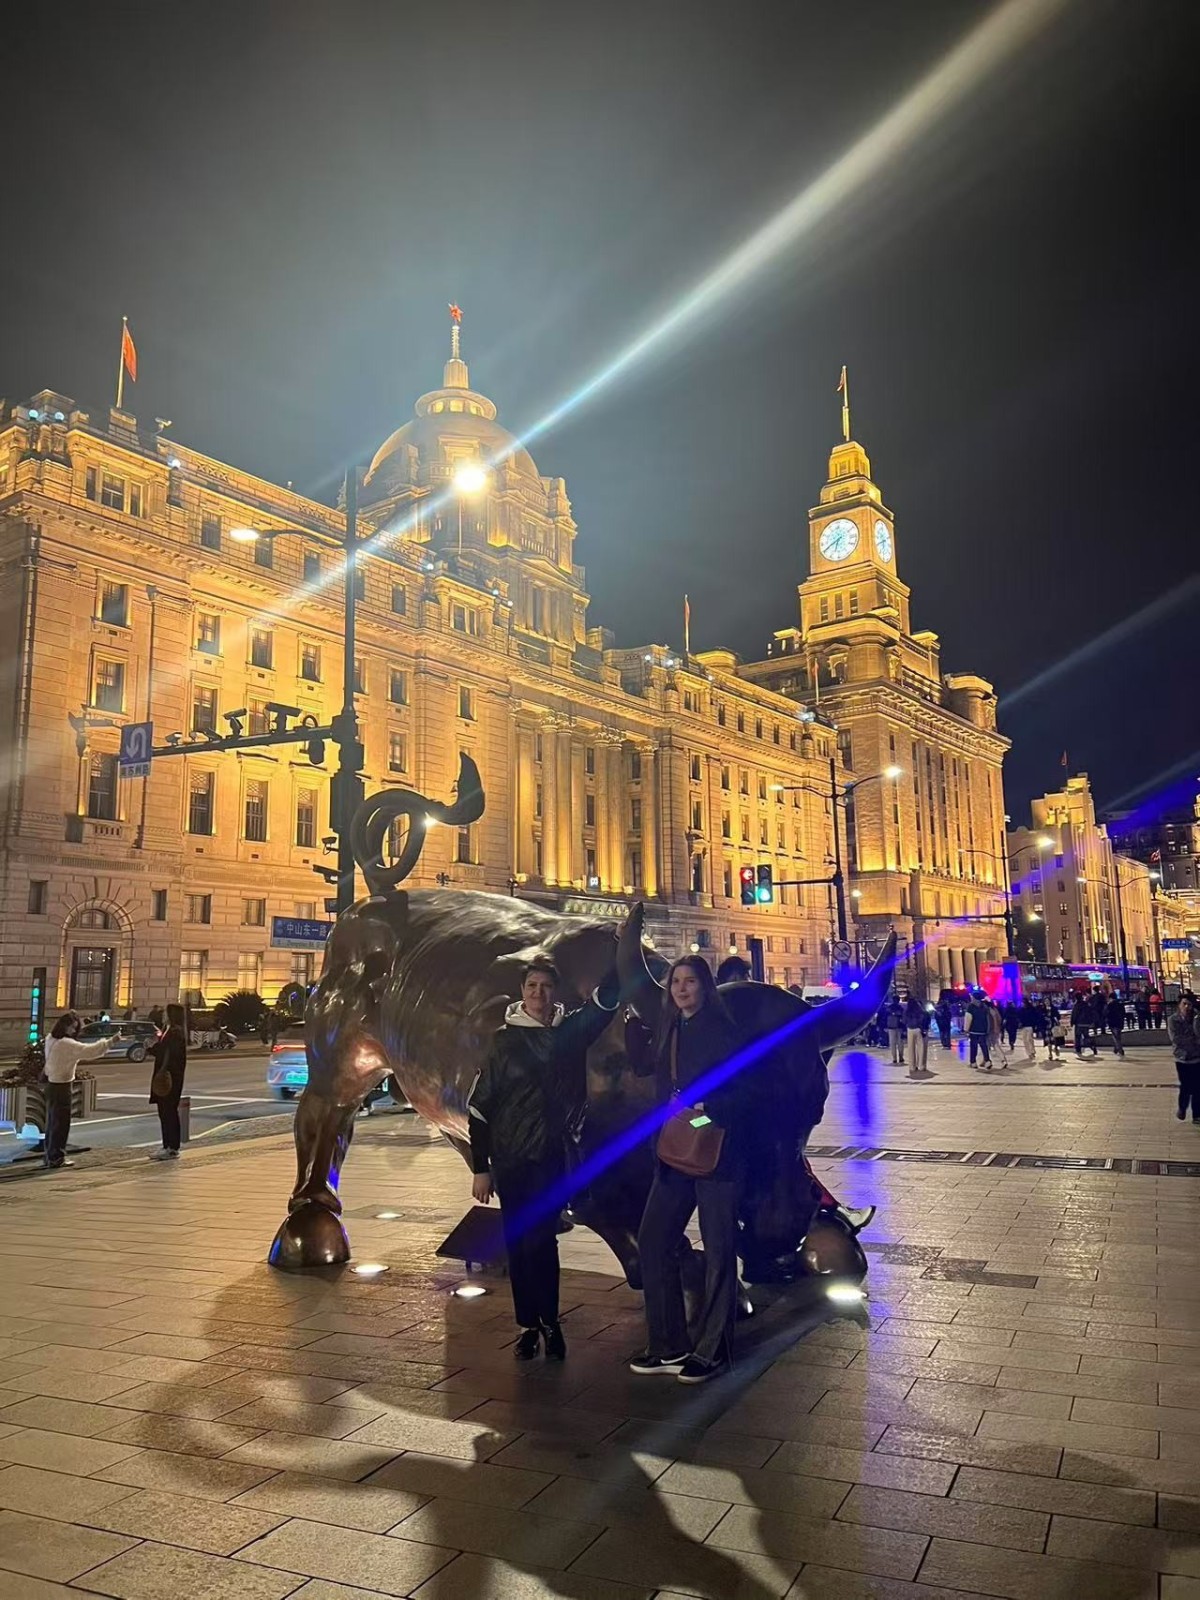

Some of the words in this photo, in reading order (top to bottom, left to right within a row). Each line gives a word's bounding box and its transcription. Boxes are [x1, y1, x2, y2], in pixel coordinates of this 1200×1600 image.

[286, 922, 327, 937] 中山东一路
